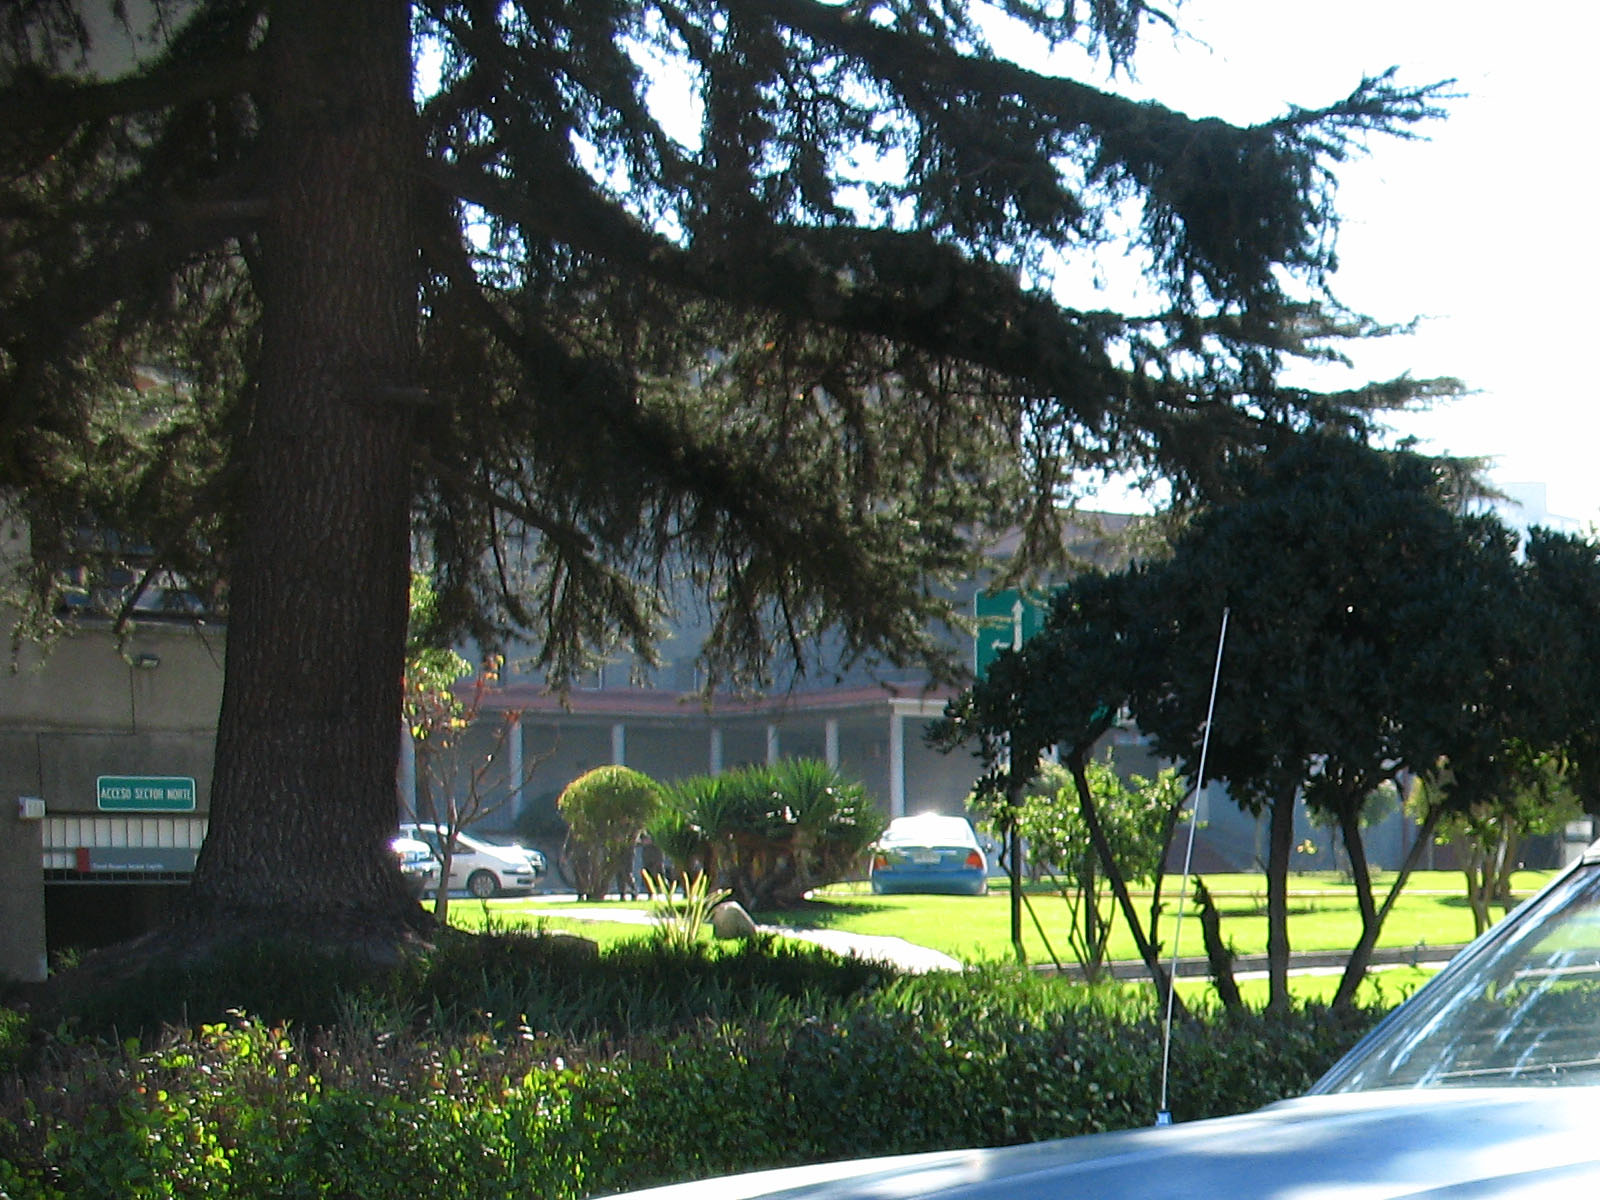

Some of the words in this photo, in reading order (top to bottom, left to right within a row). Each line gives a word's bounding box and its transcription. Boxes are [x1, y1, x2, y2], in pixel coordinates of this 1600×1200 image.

[101, 787, 132, 800] ACCESO
[134, 788, 164, 801] SECTOR
[167, 788, 191, 801] NORTE
